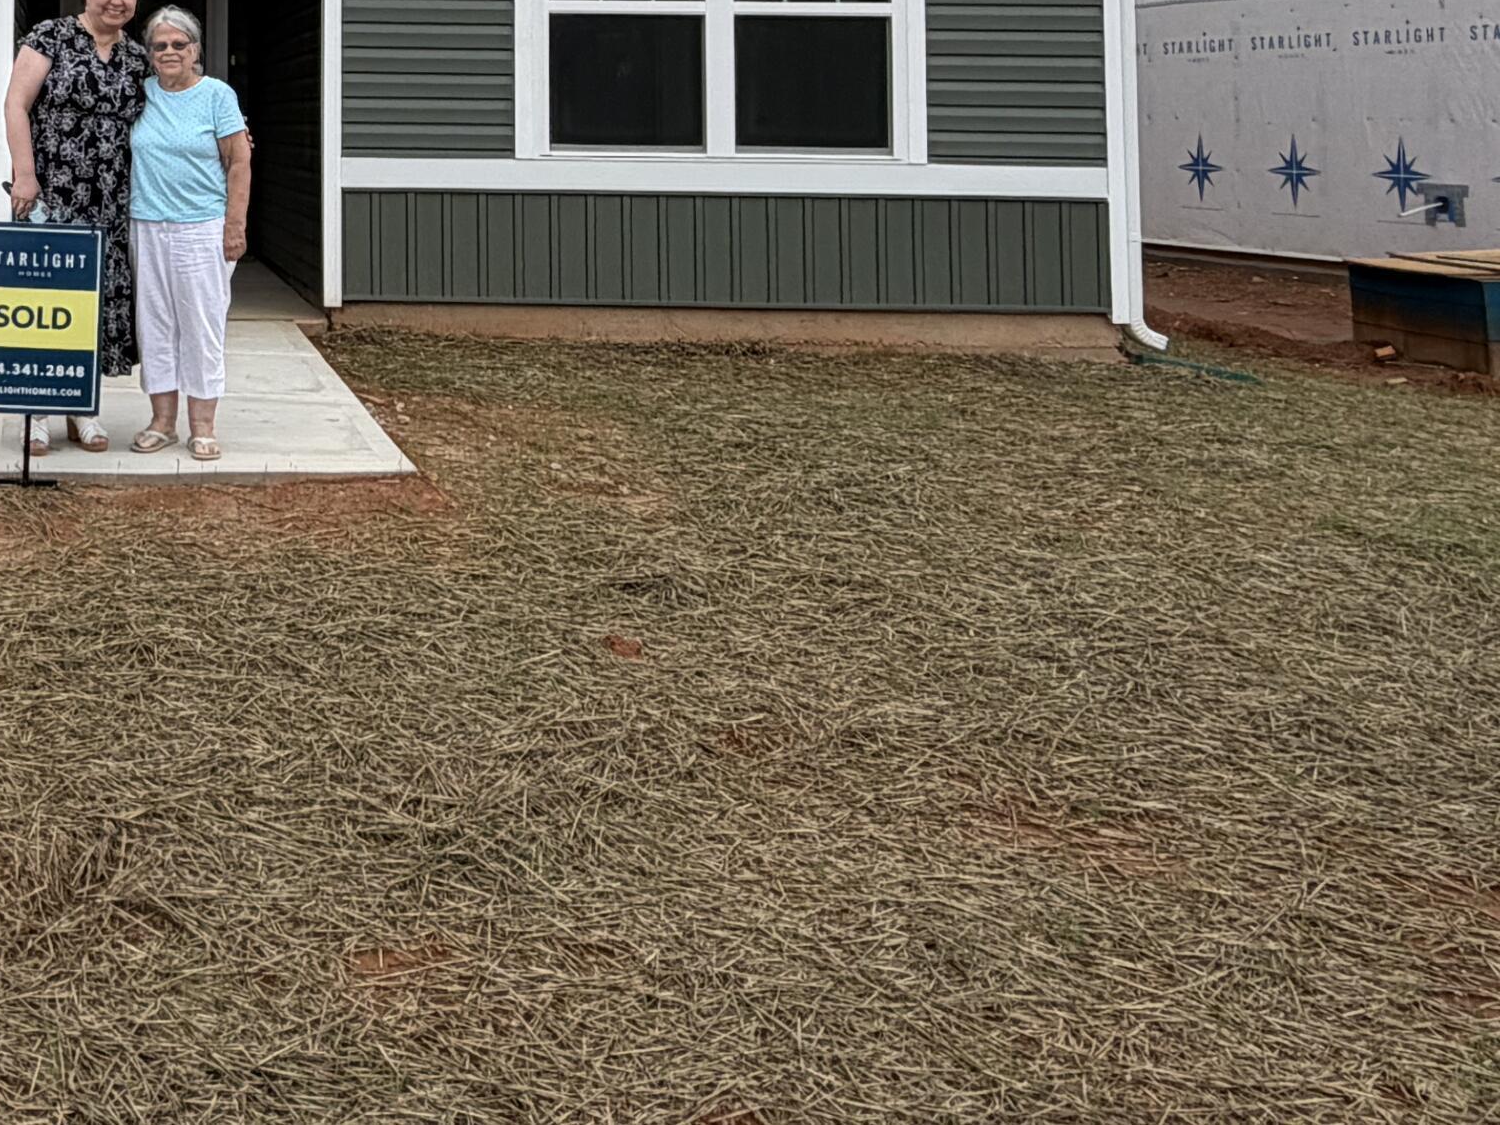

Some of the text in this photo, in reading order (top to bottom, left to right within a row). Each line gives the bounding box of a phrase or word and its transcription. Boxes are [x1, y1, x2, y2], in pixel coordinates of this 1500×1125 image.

[1162, 31, 1235, 55] STARLIGHT
[1250, 27, 1332, 51] STARLIGHT
[1352, 19, 1445, 46] STARLIGHT
